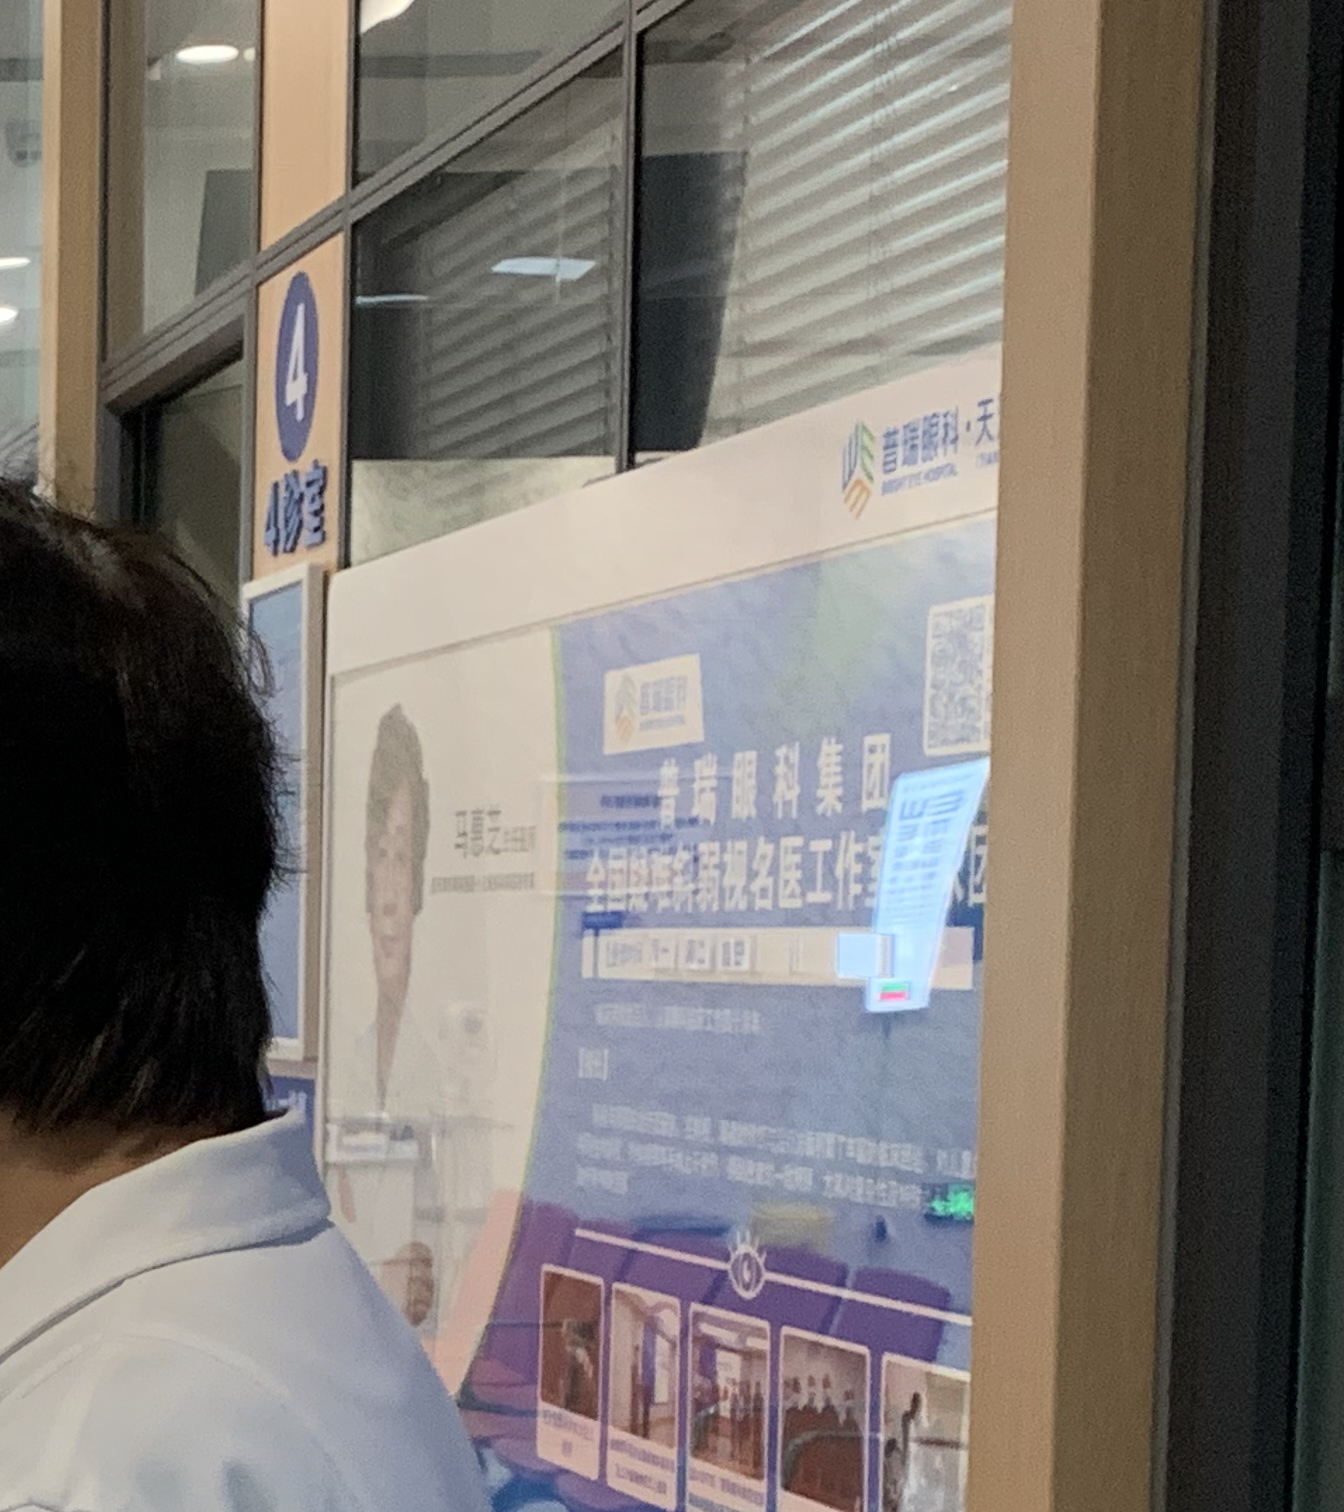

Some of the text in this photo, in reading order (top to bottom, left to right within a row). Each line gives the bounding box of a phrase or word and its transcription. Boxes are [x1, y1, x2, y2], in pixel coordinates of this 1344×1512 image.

[285, 302, 308, 423] 4
[265, 459, 328, 558] 4诊室
[658, 733, 891, 831] 普瑞眼科集团
